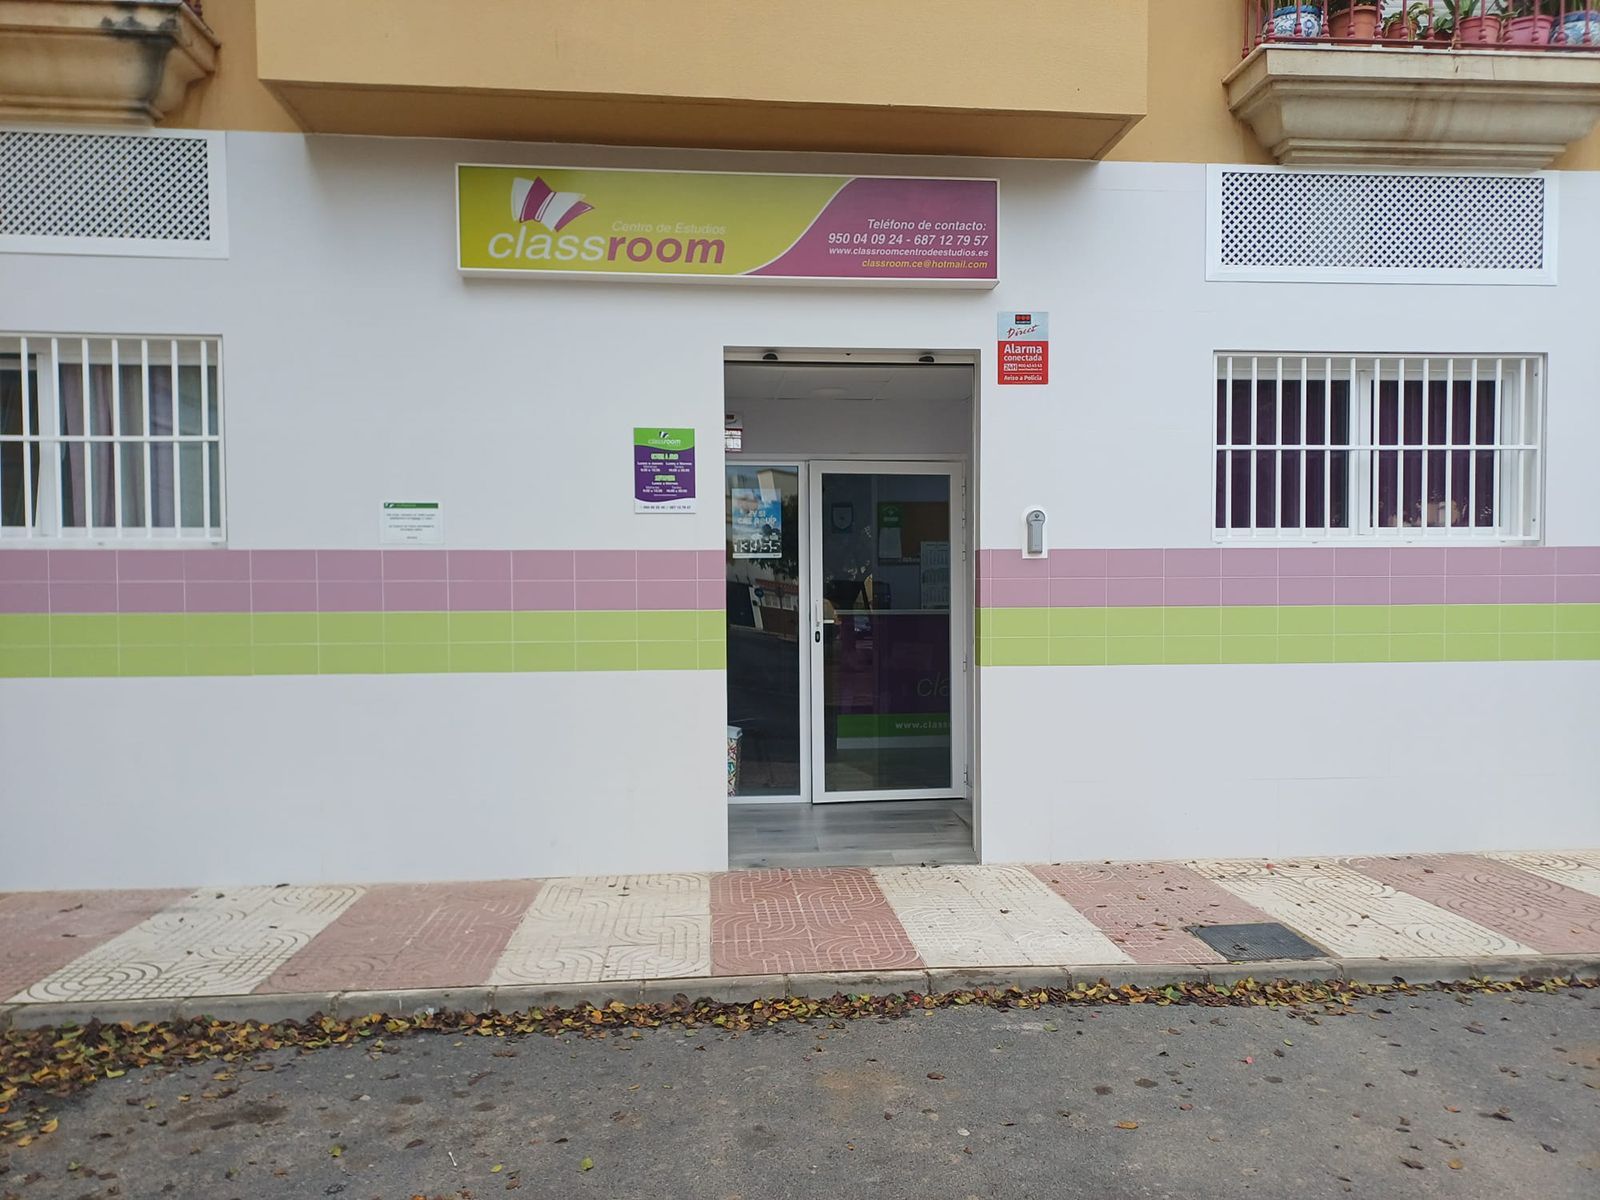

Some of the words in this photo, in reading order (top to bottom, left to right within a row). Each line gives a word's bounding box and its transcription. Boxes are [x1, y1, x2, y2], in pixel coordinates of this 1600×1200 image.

[612, 221, 653, 232] Centro
[656, 223, 671, 232] de
[675, 223, 726, 234] Estudios
[868, 218, 915, 230] Teléfono
[918, 221, 932, 230] de
[935, 221, 986, 231] contacto:
[488, 225, 725, 264] classroom
[828, 233, 850, 244] 950
[853, 234, 868, 244] 04
[871, 234, 886, 244] 09
[888, 234, 903, 245] 24
[914, 234, 936, 245] 687
[940, 235, 953, 246] 12
[957, 235, 971, 246] 79
[973, 235, 989, 246] 57
[862, 258, 988, 269] classroom.ce@hotmail.com
[1004, 343, 1042, 354] Alarma
